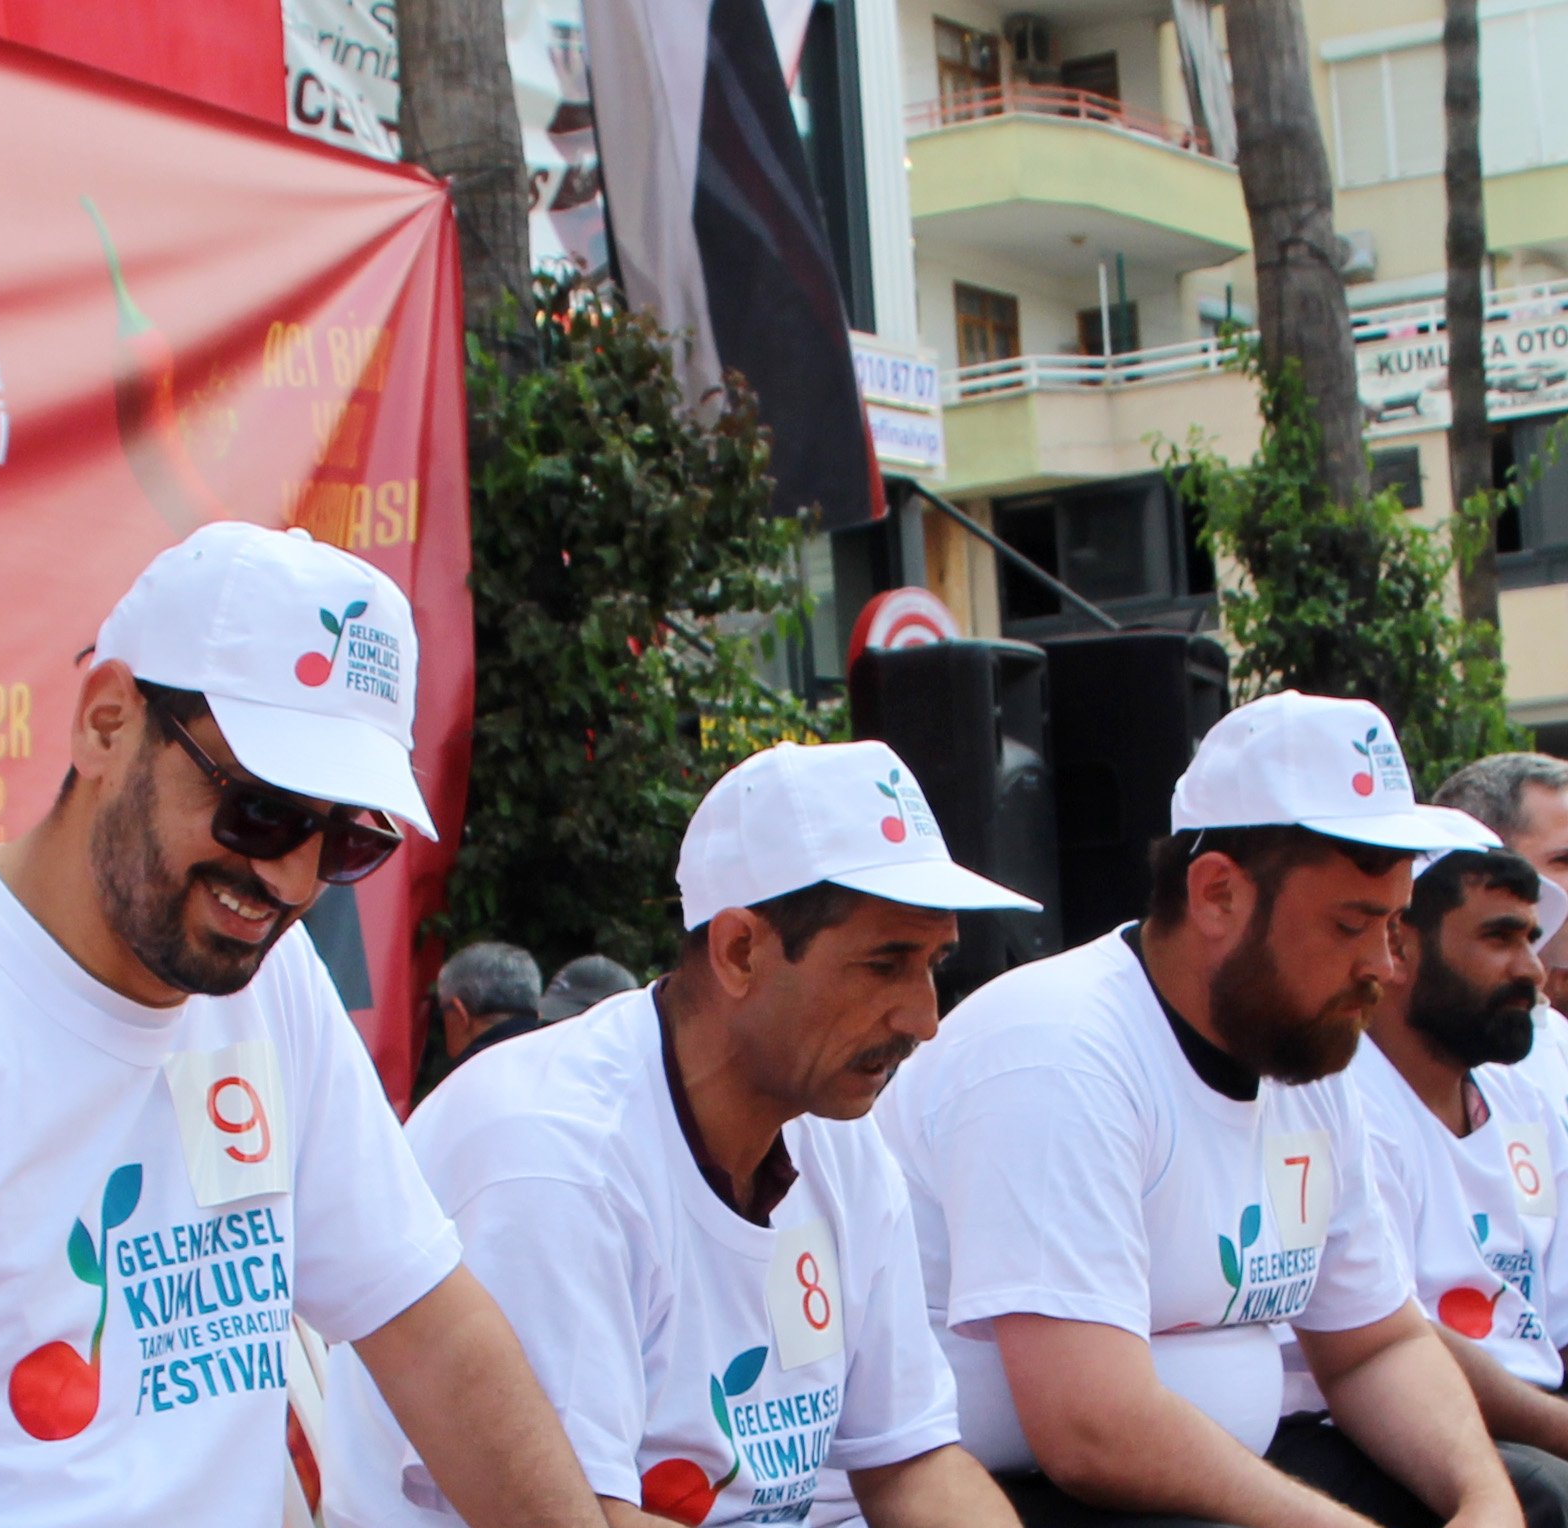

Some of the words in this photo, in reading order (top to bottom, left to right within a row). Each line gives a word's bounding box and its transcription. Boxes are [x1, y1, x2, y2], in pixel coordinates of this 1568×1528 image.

[1376, 336, 1506, 376] KUMLA
[1517, 325, 1568, 354] OTO
[348, 641, 400, 672] KUMLUCA
[205, 1075, 272, 1165] 9
[1284, 1156, 1313, 1224] 7
[1507, 1142, 1539, 1196] 6
[116, 1207, 284, 1278] GELENEKSEL
[123, 1253, 290, 1330] KUMLUCA
[795, 1251, 831, 1331] 8
[138, 1330, 175, 1360] TARIM
[178, 1325, 205, 1350] VE
[136, 1340, 288, 1416] FESTİVAL
[742, 1426, 832, 1482] KUMLUC
